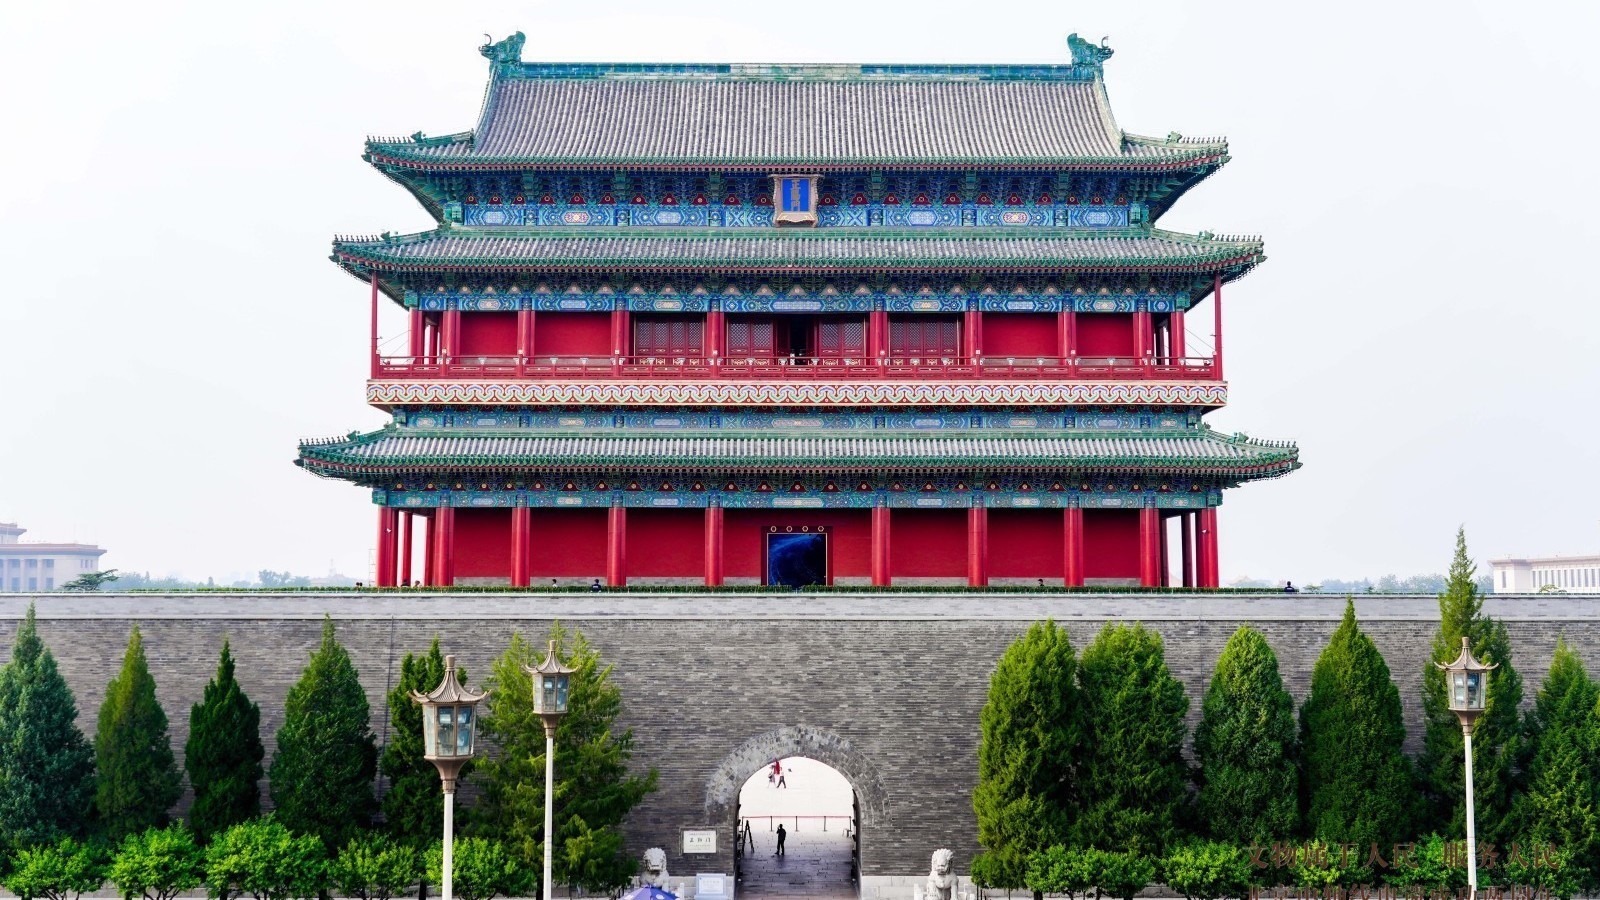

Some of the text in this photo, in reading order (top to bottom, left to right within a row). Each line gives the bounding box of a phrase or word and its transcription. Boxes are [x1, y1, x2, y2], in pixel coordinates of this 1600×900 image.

[1243, 841, 1561, 869] 文物属于人民 服务人民
